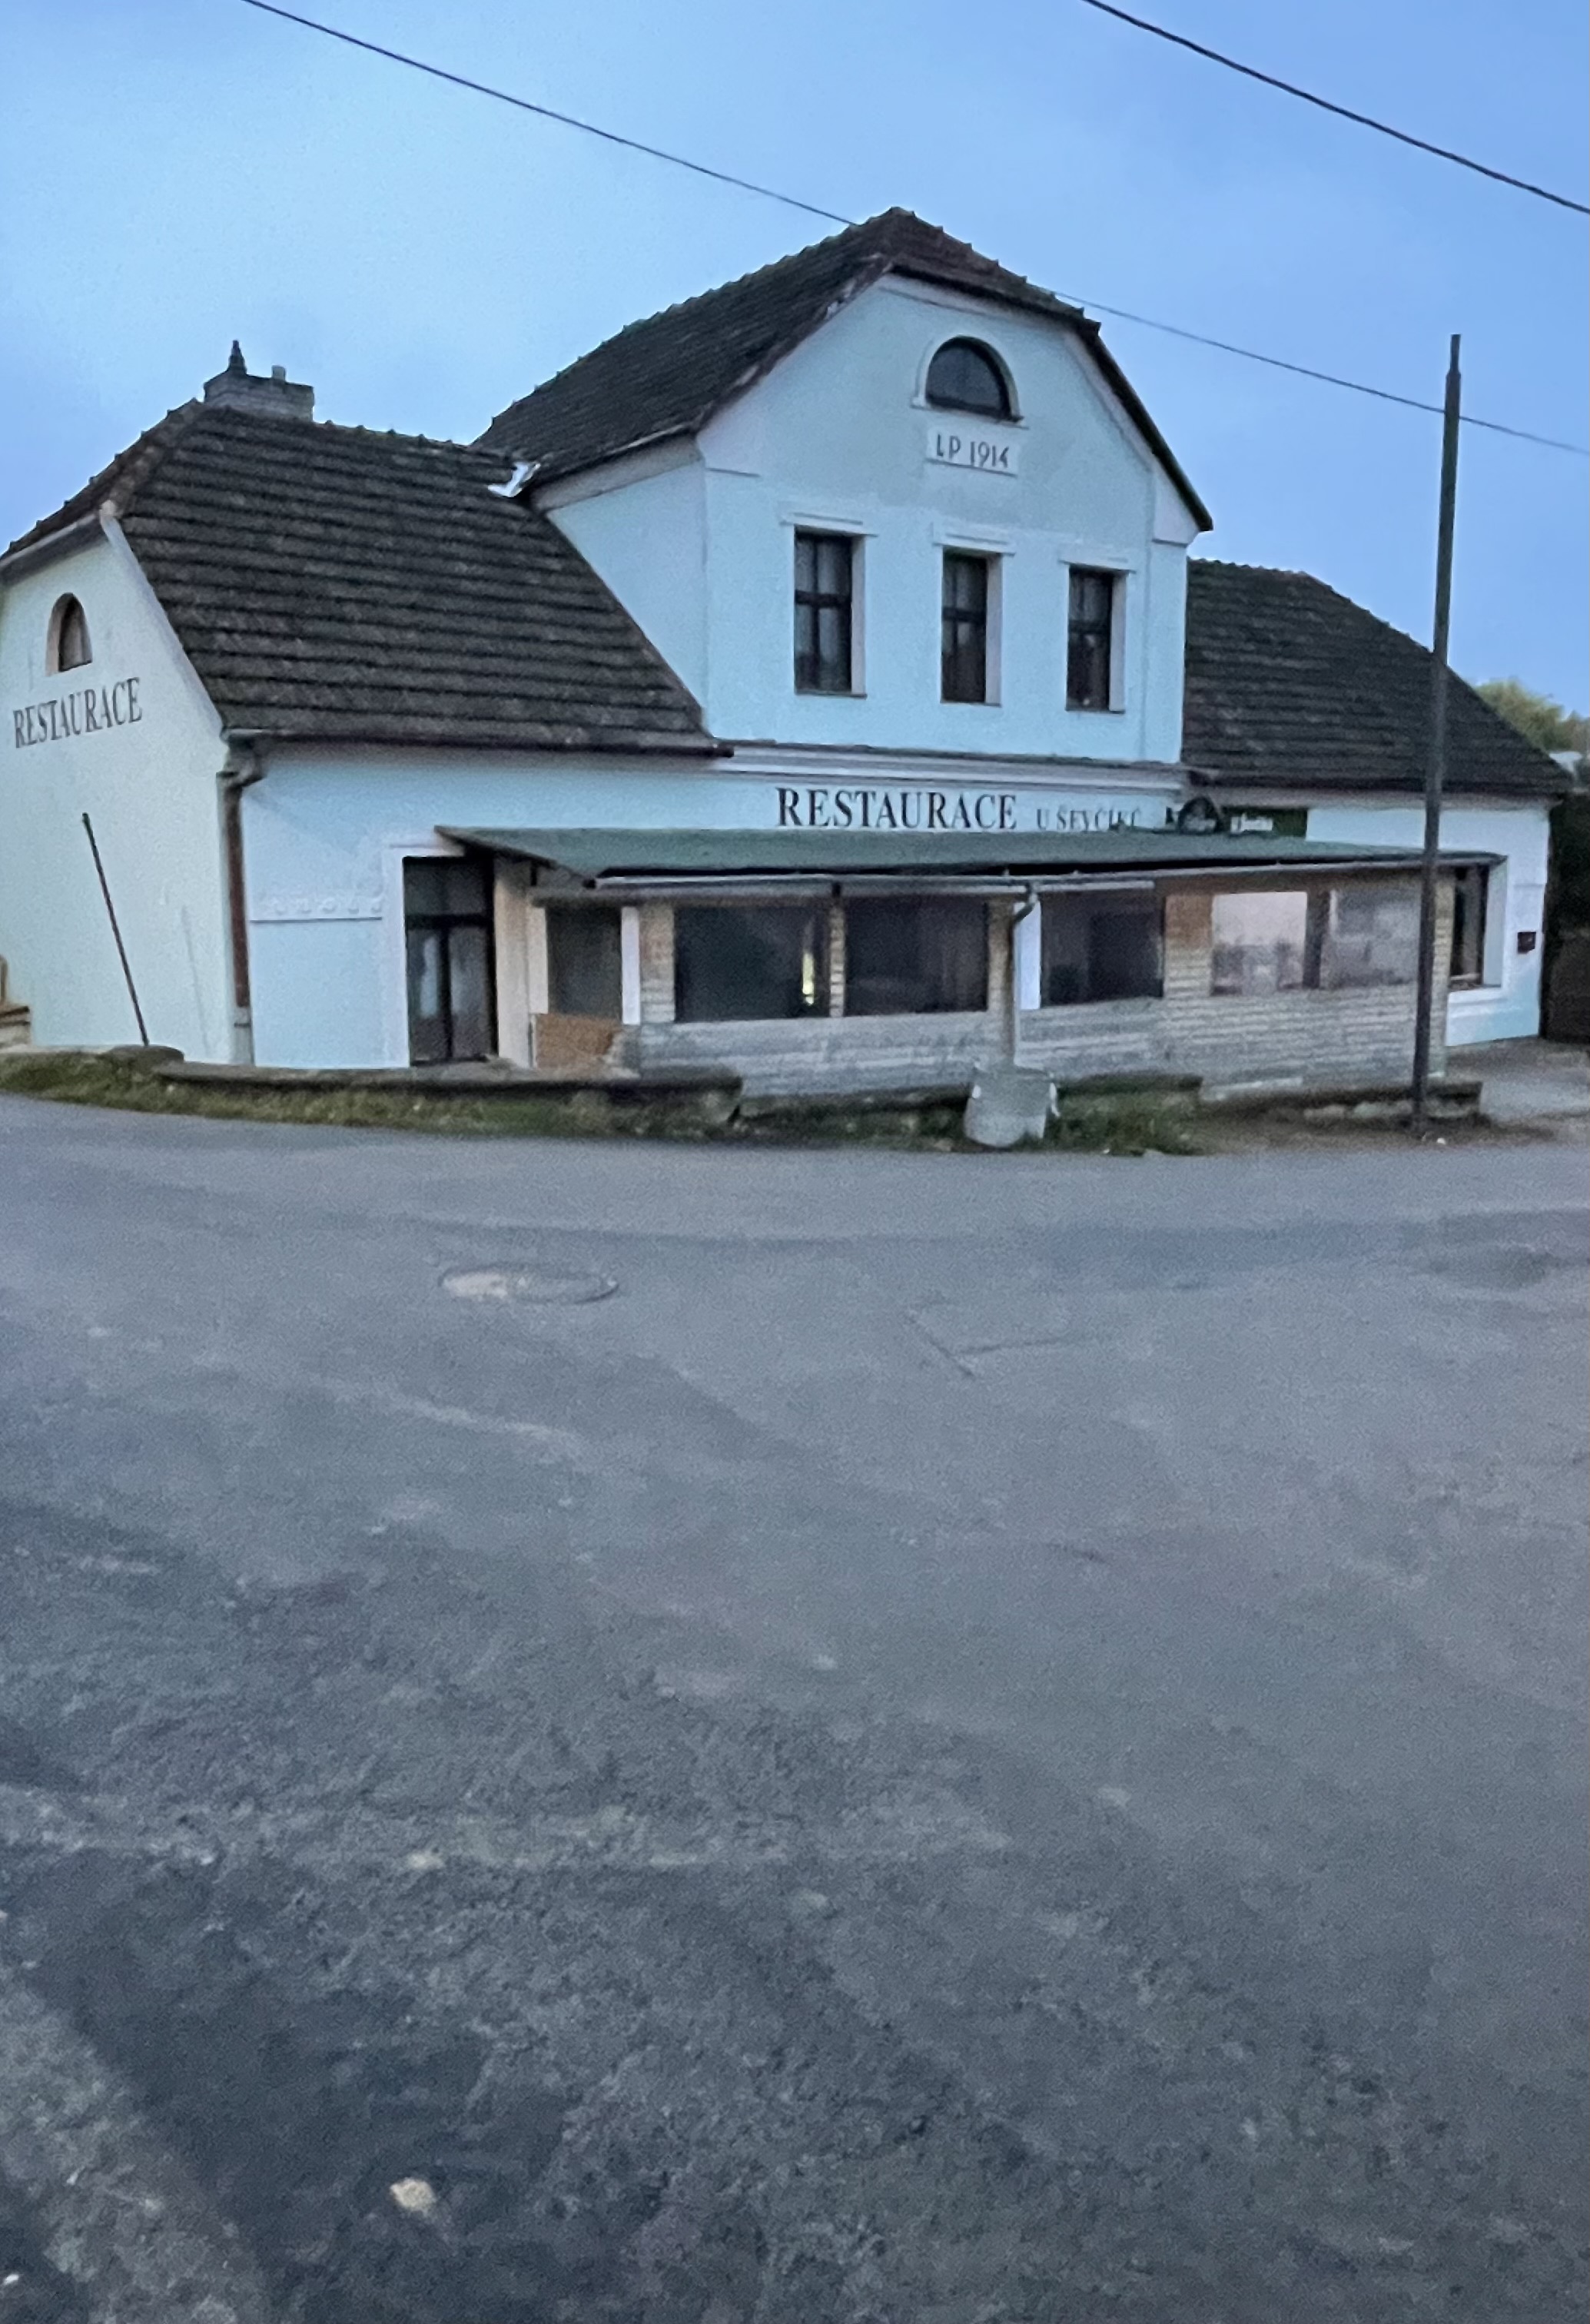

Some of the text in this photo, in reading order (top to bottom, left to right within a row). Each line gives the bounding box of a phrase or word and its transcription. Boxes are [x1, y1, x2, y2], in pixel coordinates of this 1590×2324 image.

[970, 440, 1009, 468] 1914
[13, 676, 143, 749] RESTAURACE
[776, 787, 1017, 830] RESTAURACE
[1036, 808, 1050, 831] U
